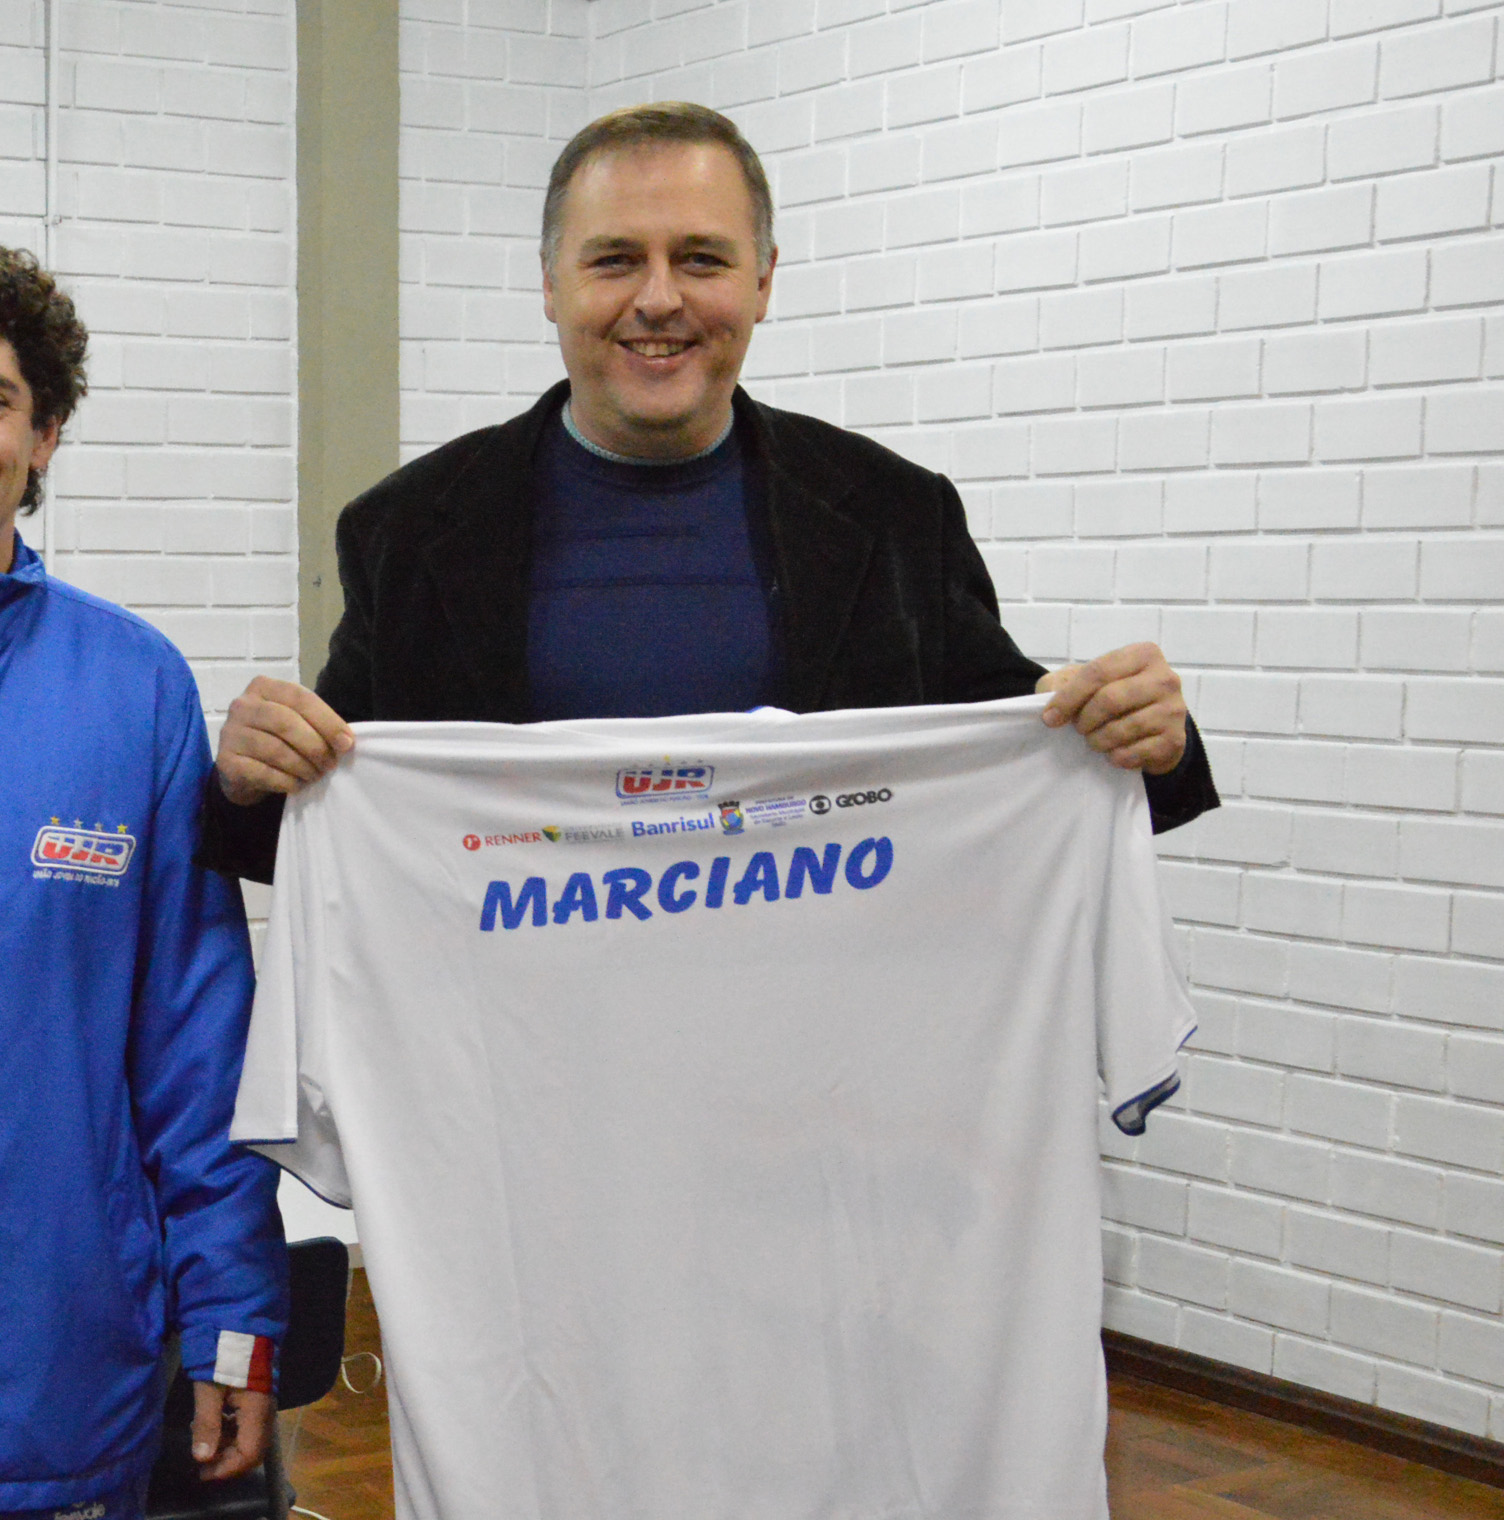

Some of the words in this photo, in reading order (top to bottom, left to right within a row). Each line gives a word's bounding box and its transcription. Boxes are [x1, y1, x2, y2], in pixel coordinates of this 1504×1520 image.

[624, 768, 705, 794] UJR
[836, 787, 893, 809] GLOBO
[565, 827, 625, 841] FEEVALE
[632, 813, 715, 838] Banrisul
[43, 835, 124, 866] UJR
[485, 831, 541, 847] RENNER
[480, 837, 894, 931] MARCIANO
